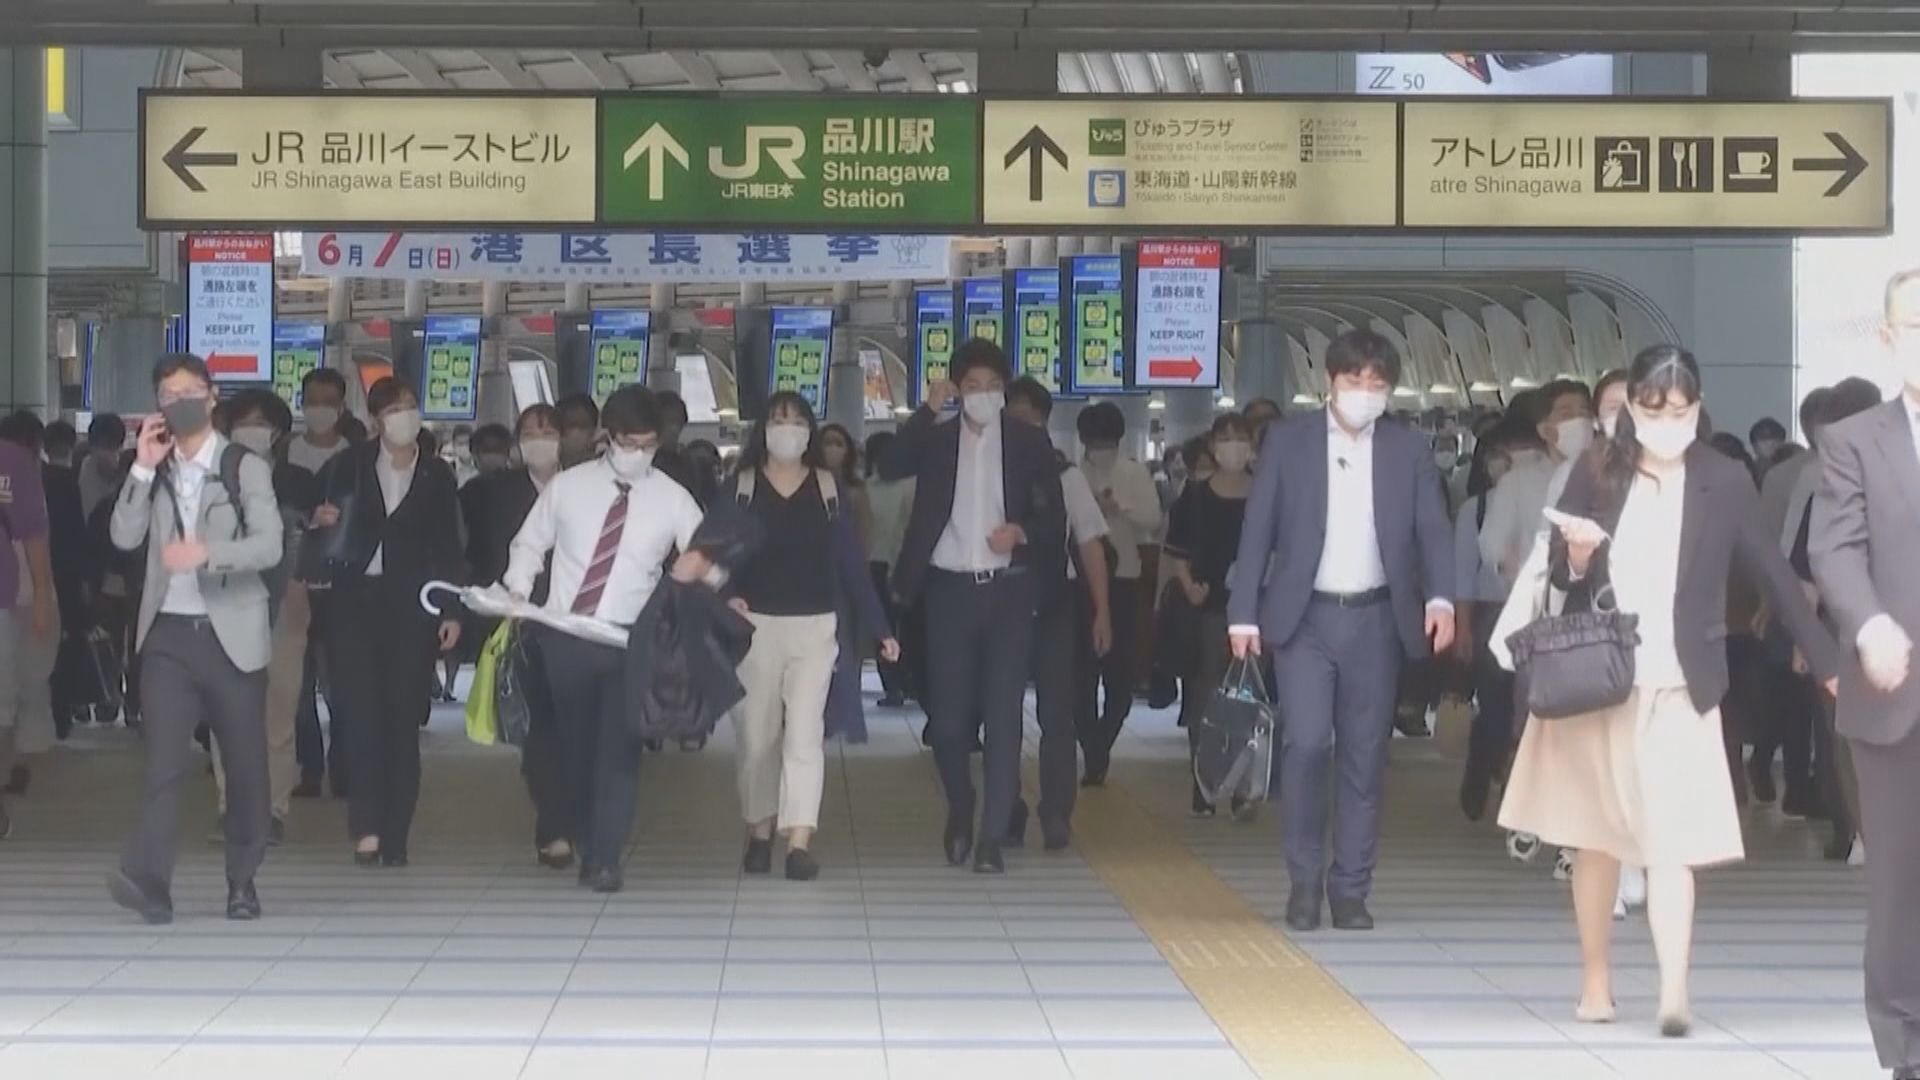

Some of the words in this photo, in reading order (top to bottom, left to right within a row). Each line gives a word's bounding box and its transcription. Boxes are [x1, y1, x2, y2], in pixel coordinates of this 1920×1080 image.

[1403, 74, 1425, 90] 50
[822, 117, 936, 156] 品川駅
[1134, 118, 1234, 138] びゅうプラザ
[252, 131, 304, 165] JR
[321, 132, 571, 165] 品川イーストビル
[708, 126, 807, 179] JR
[1430, 137, 1584, 169] アトレ品川
[251, 171, 278, 189] JR
[284, 171, 392, 193] Shinagawa
[399, 171, 443, 190] East
[449, 171, 526, 192] Building
[822, 161, 950, 186] Shinagawa
[721, 182, 795, 200] JR東日本
[1430, 177, 1468, 194] atre
[1474, 176, 1582, 197] Shinagawa
[822, 189, 905, 209] Station
[215, 251, 247, 260] NOTICE
[1163, 257, 1195, 266] NOTICE
[205, 324, 231, 335] KEEP
[232, 324, 256, 335] LEFT
[1150, 329, 1175, 340] KEEP
[1176, 329, 1205, 340] RIGHT
